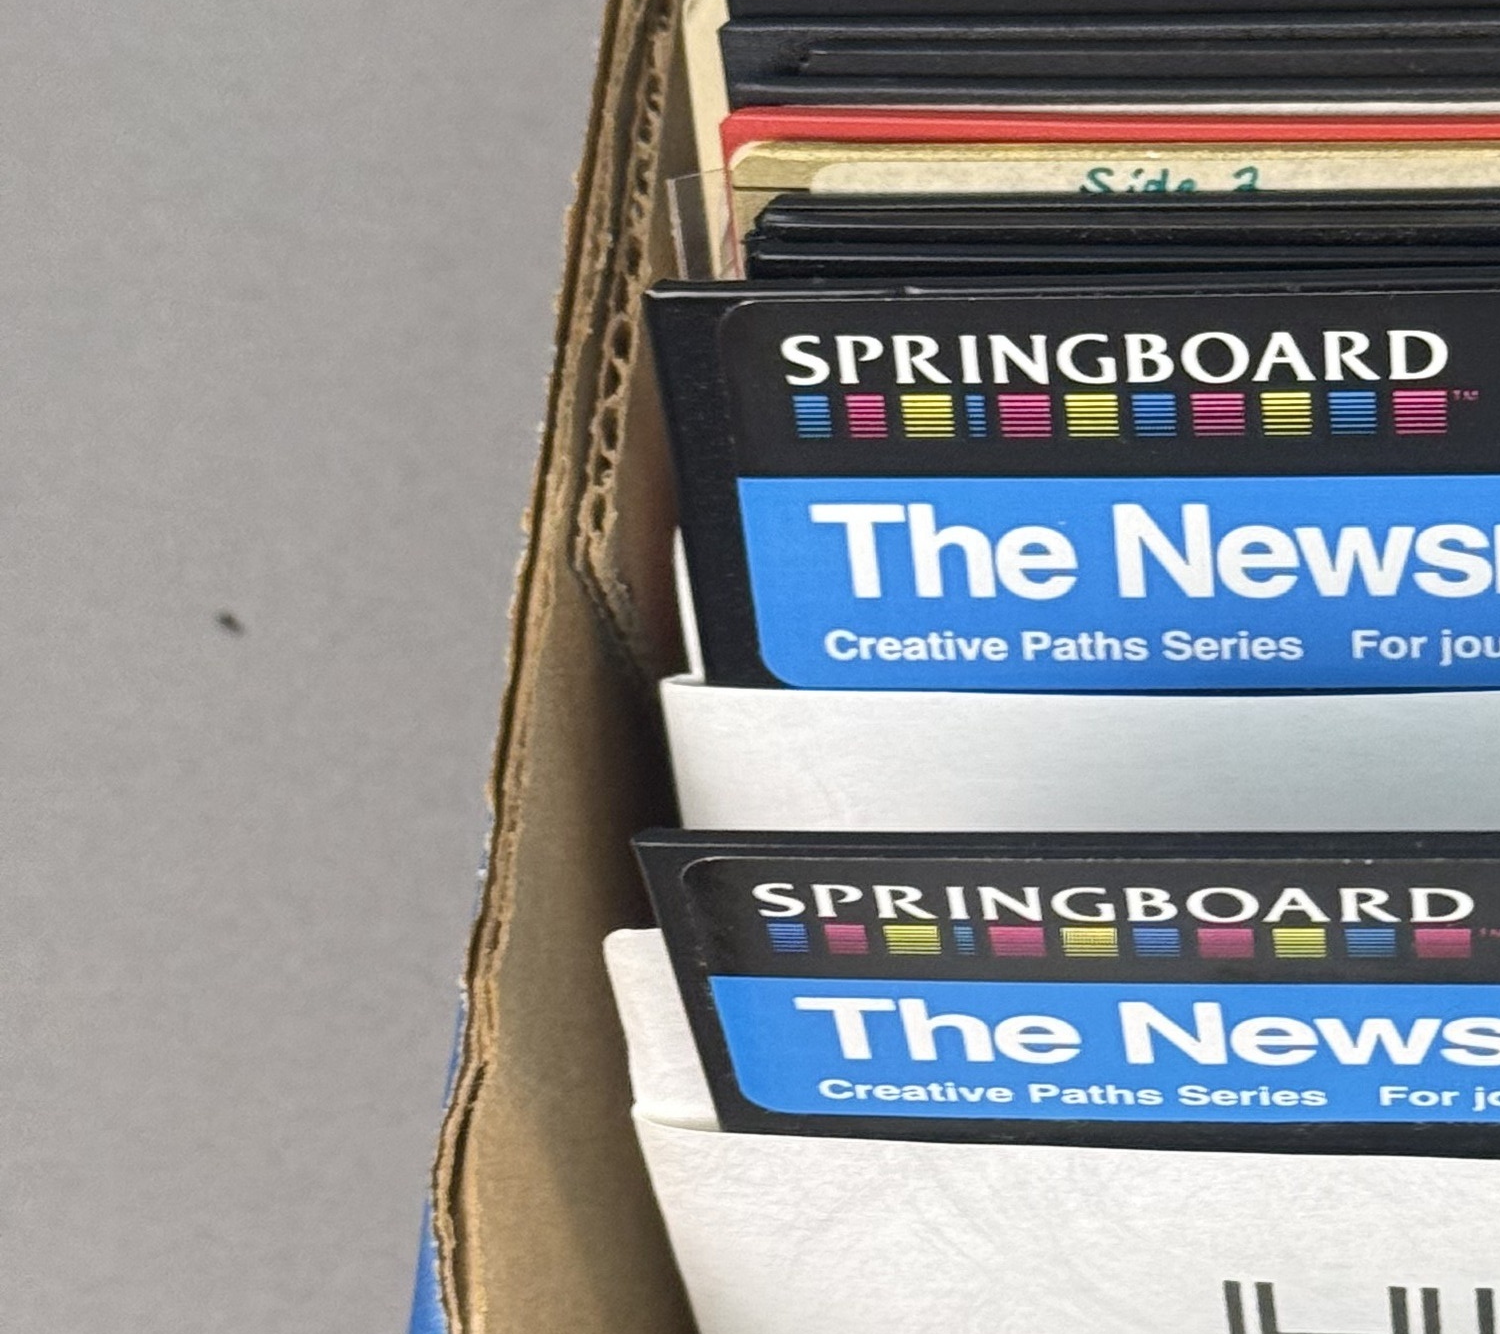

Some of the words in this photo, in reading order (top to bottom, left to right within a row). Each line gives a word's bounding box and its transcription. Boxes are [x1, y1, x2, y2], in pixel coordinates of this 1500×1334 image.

[780, 329, 1449, 386] SPRINGBOARD
[809, 503, 1079, 600] The
[824, 628, 1008, 662] Creative
[1021, 630, 1147, 662] Paths
[1161, 629, 1303, 662] Series
[1351, 628, 1426, 660] For
[751, 882, 1475, 923] SPRINGBOARD
[794, 997, 1082, 1062] The
[818, 1078, 1014, 1103] Creative
[1029, 1082, 1163, 1106] Paths
[1177, 1084, 1328, 1108] Series
[1379, 1085, 1460, 1107] For
